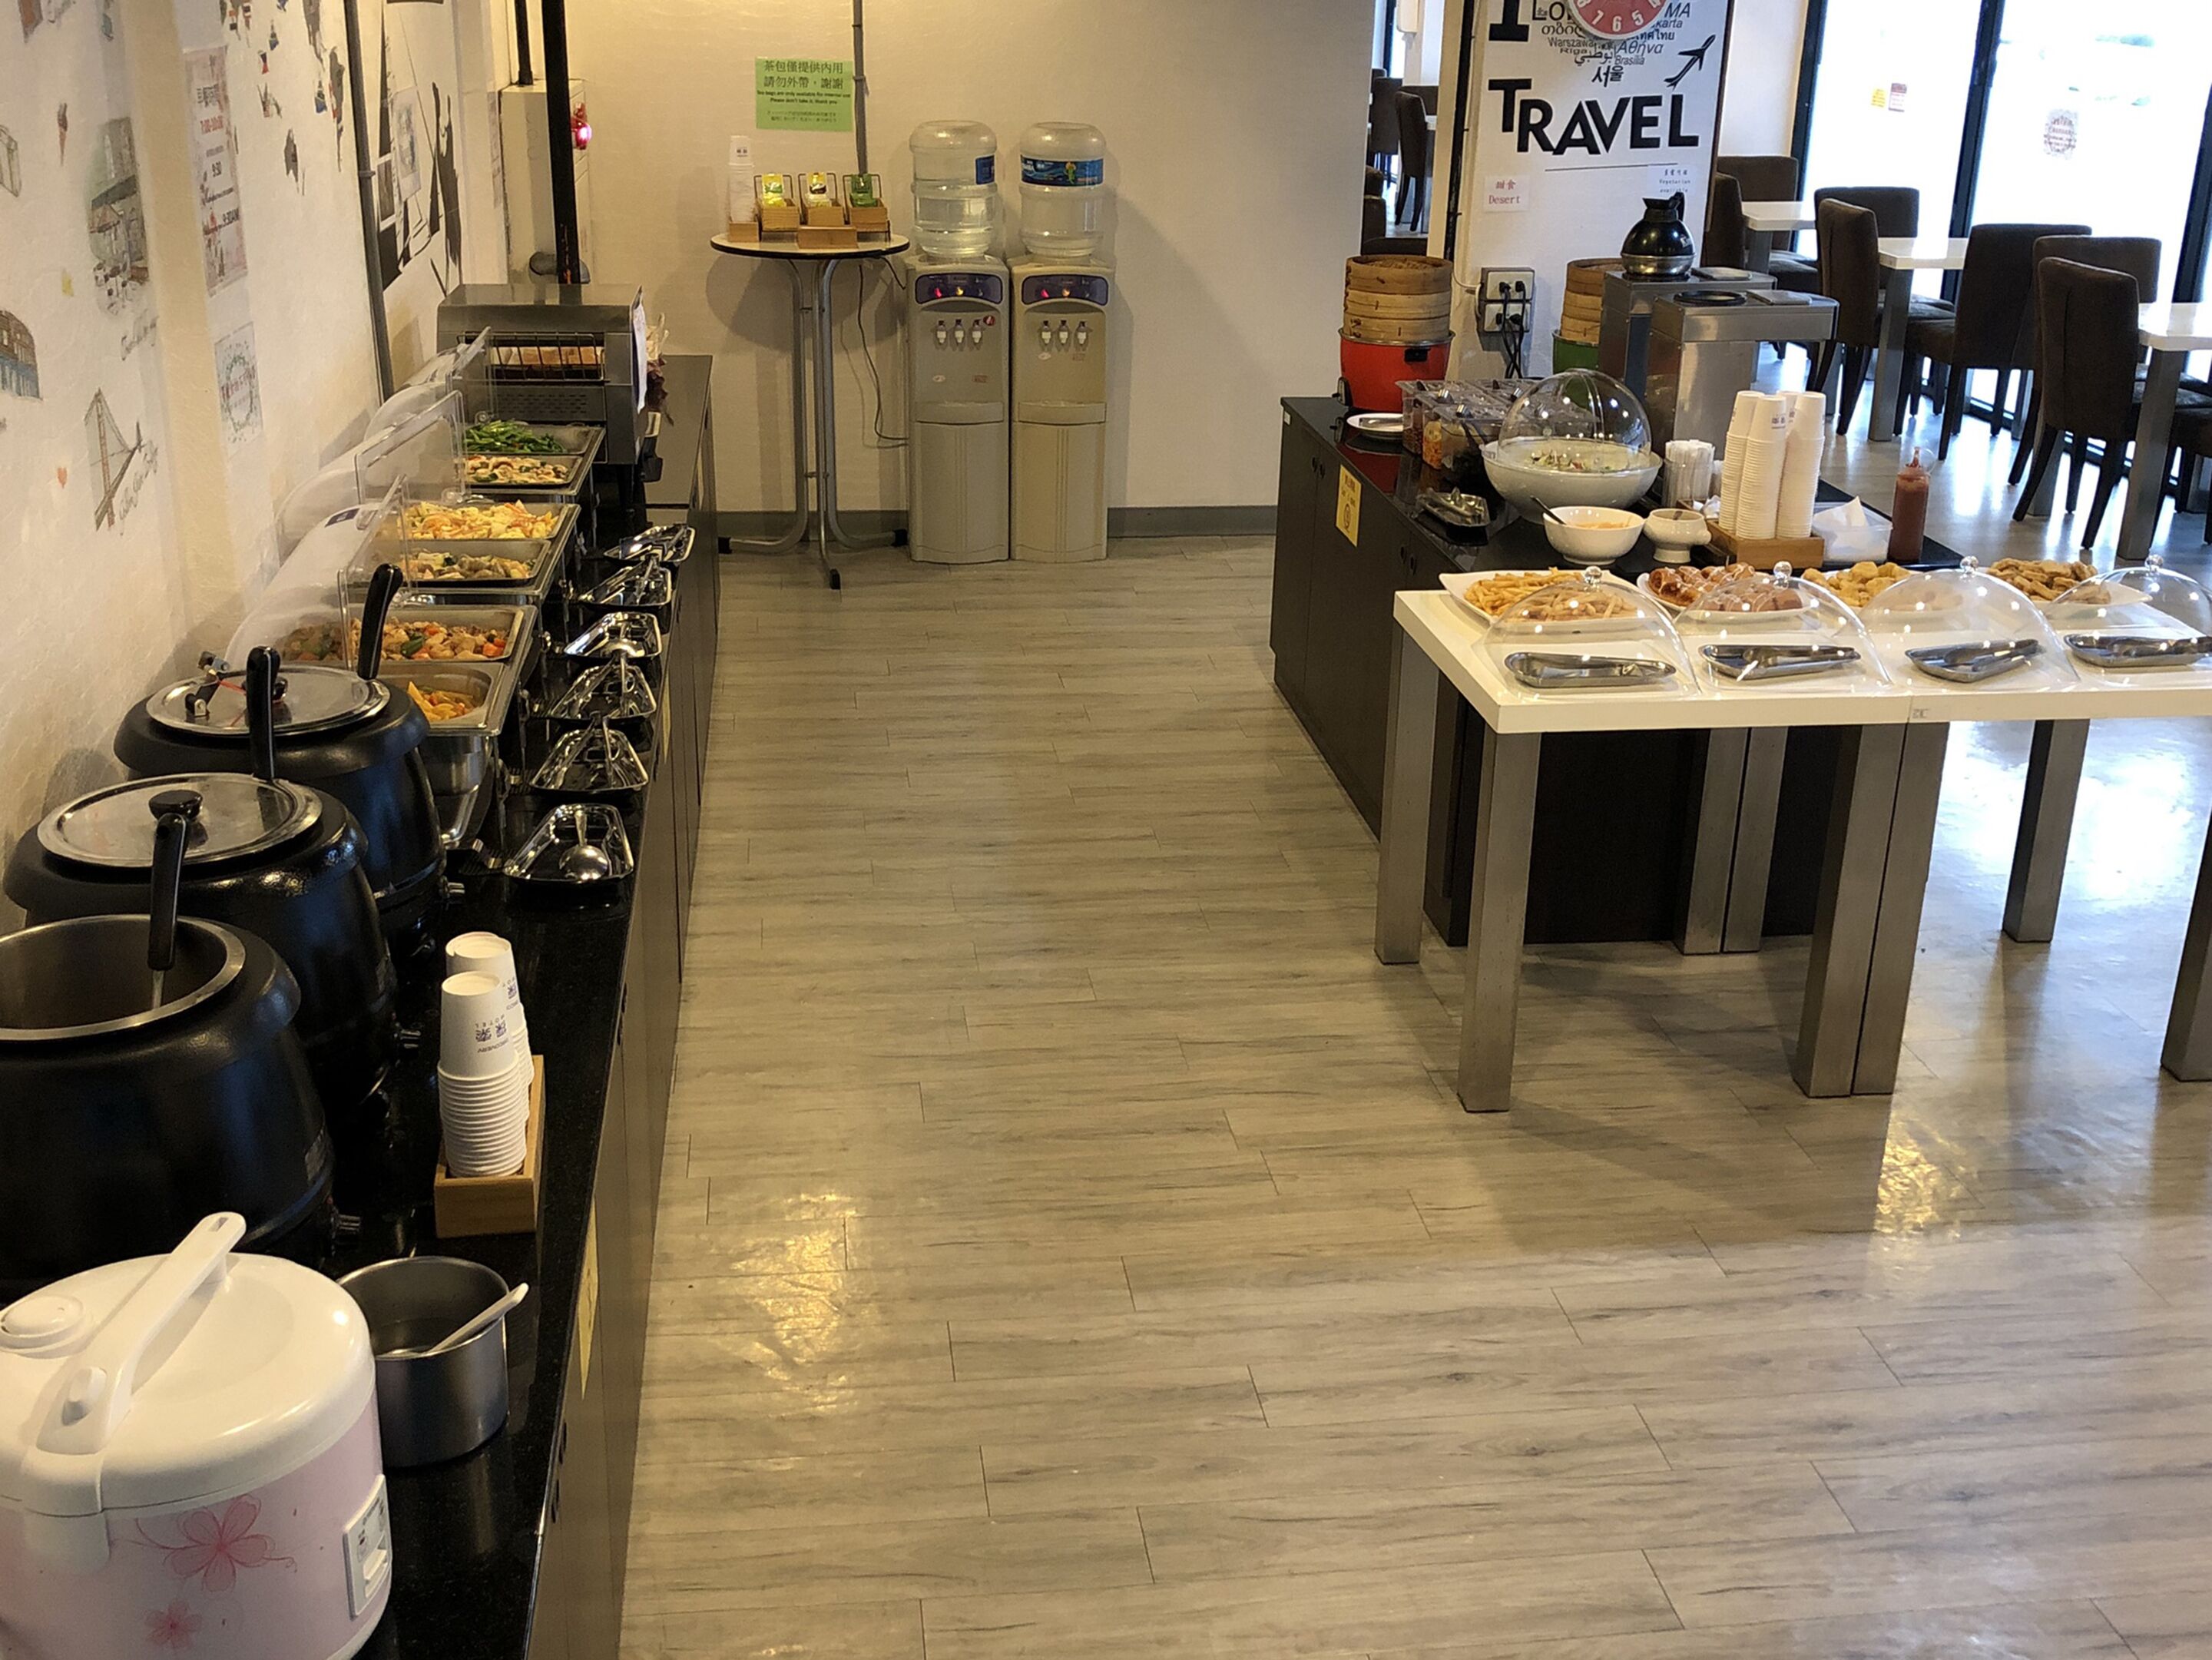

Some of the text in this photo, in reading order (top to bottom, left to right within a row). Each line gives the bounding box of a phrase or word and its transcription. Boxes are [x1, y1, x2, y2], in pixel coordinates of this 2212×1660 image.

[1612, 15, 1623, 32] 6
[1591, 65, 1624, 88] 서울
[1488, 78, 1700, 155] TRAVEL
[1488, 194, 1520, 204] Desert
